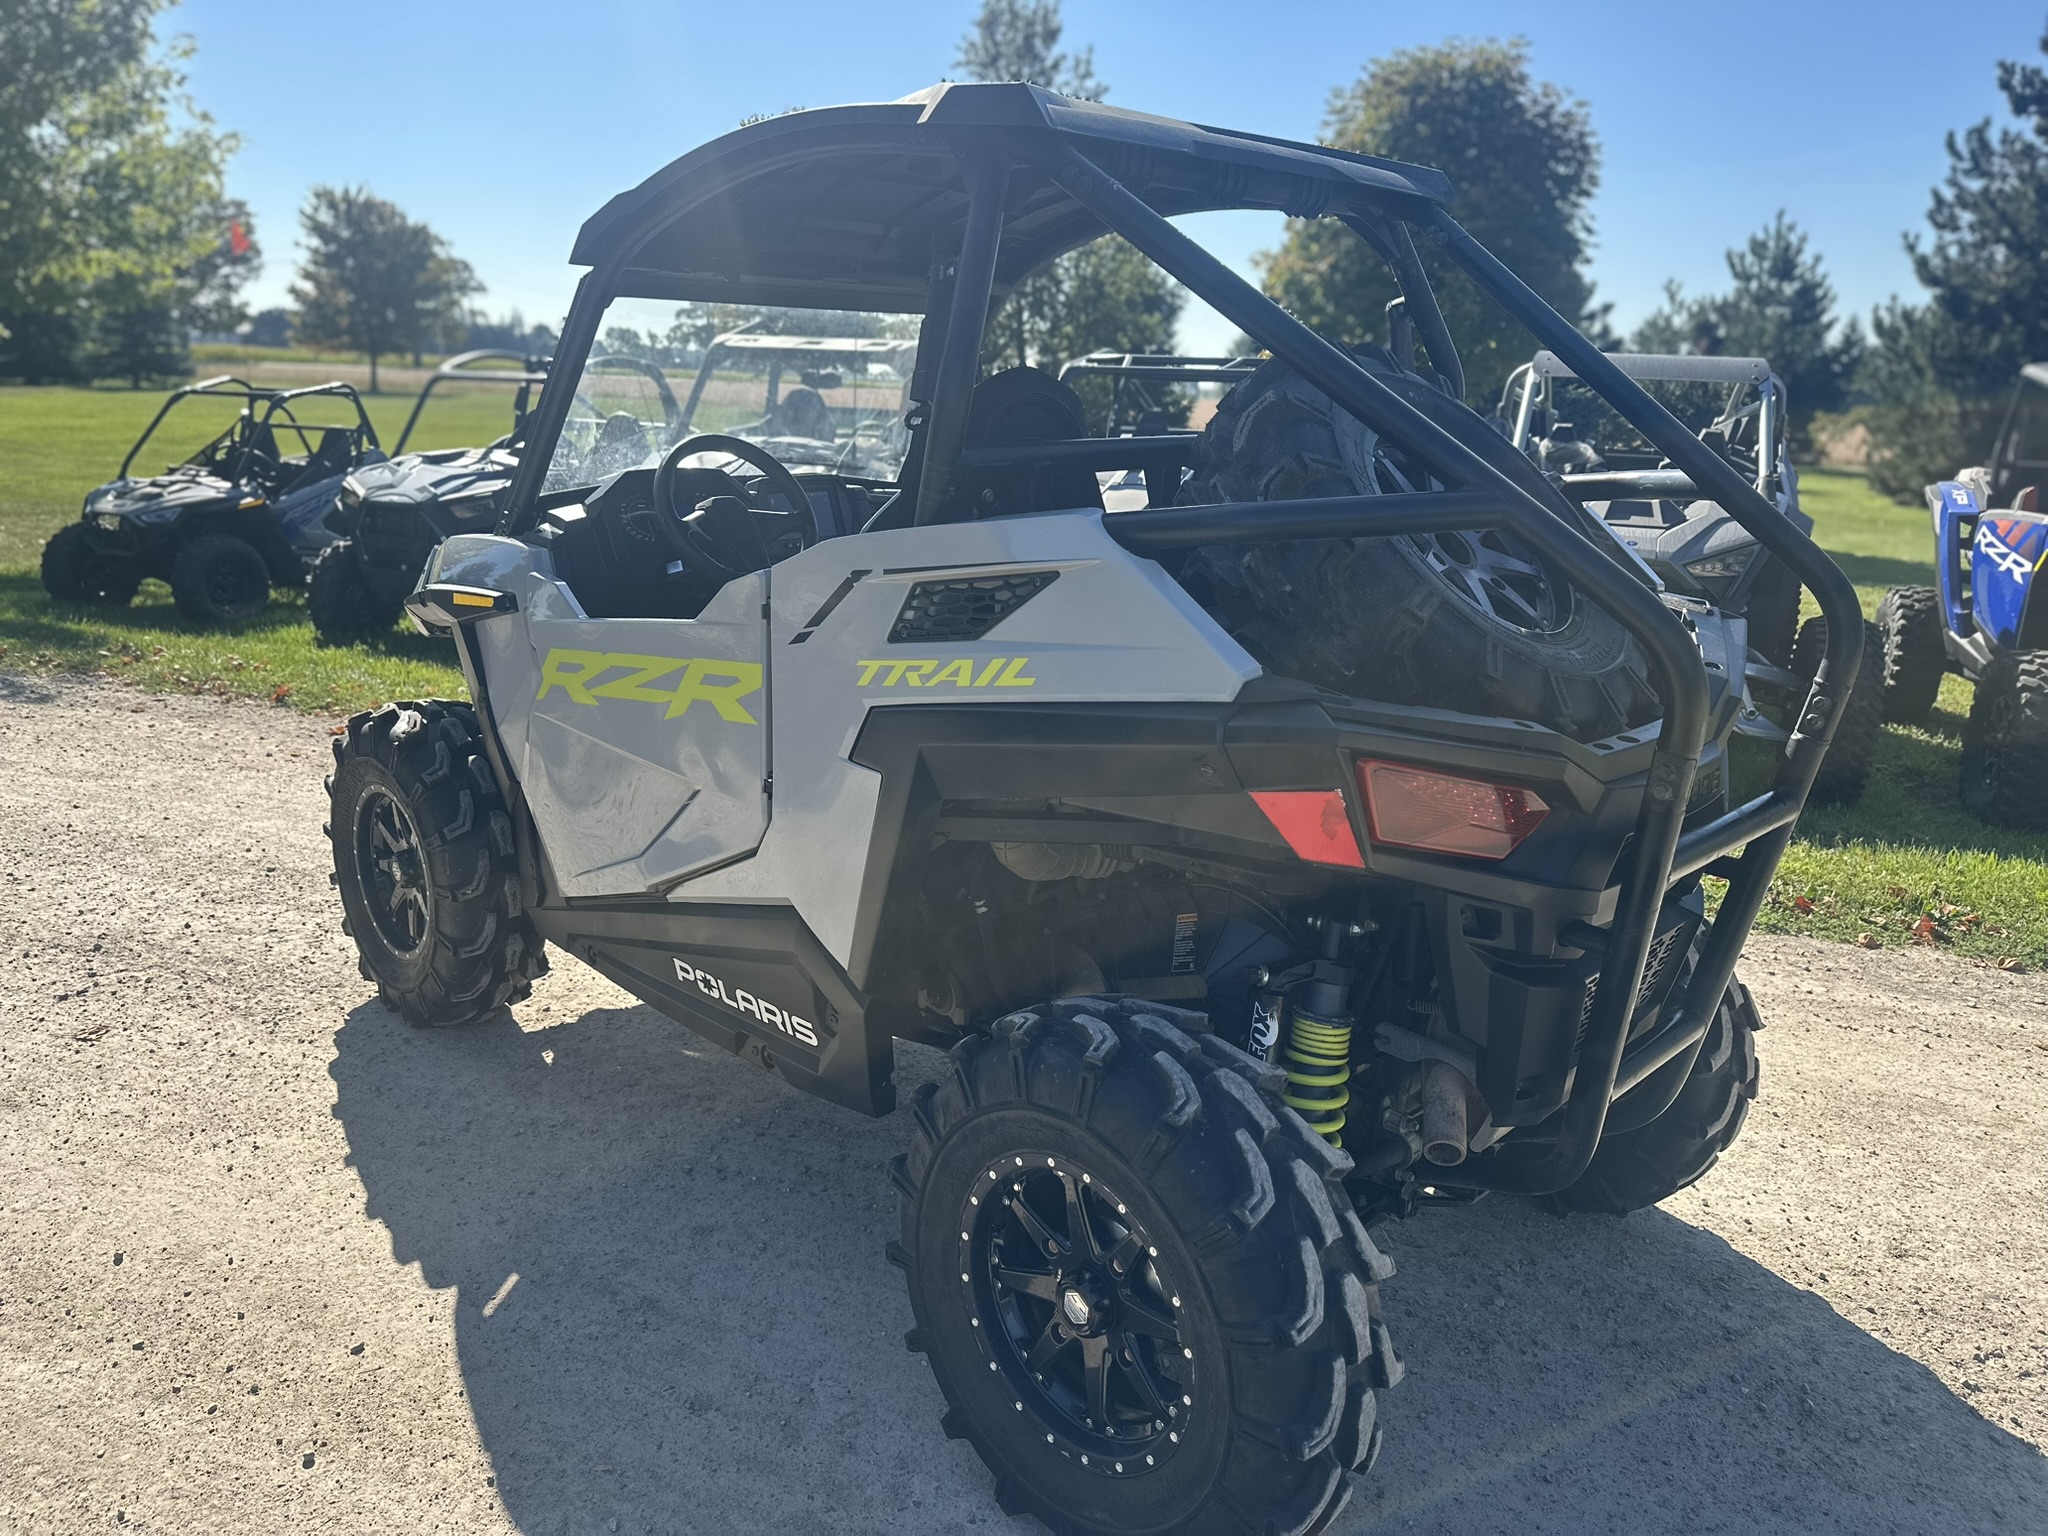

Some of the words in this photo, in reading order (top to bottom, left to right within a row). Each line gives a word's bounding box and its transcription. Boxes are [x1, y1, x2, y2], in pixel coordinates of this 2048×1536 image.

[1951, 489, 1969, 505] XP
[1974, 524, 2033, 586] RZR
[536, 648, 763, 726] RZR
[856, 657, 1037, 688] TRAIL
[672, 957, 819, 1047] POLARIS
